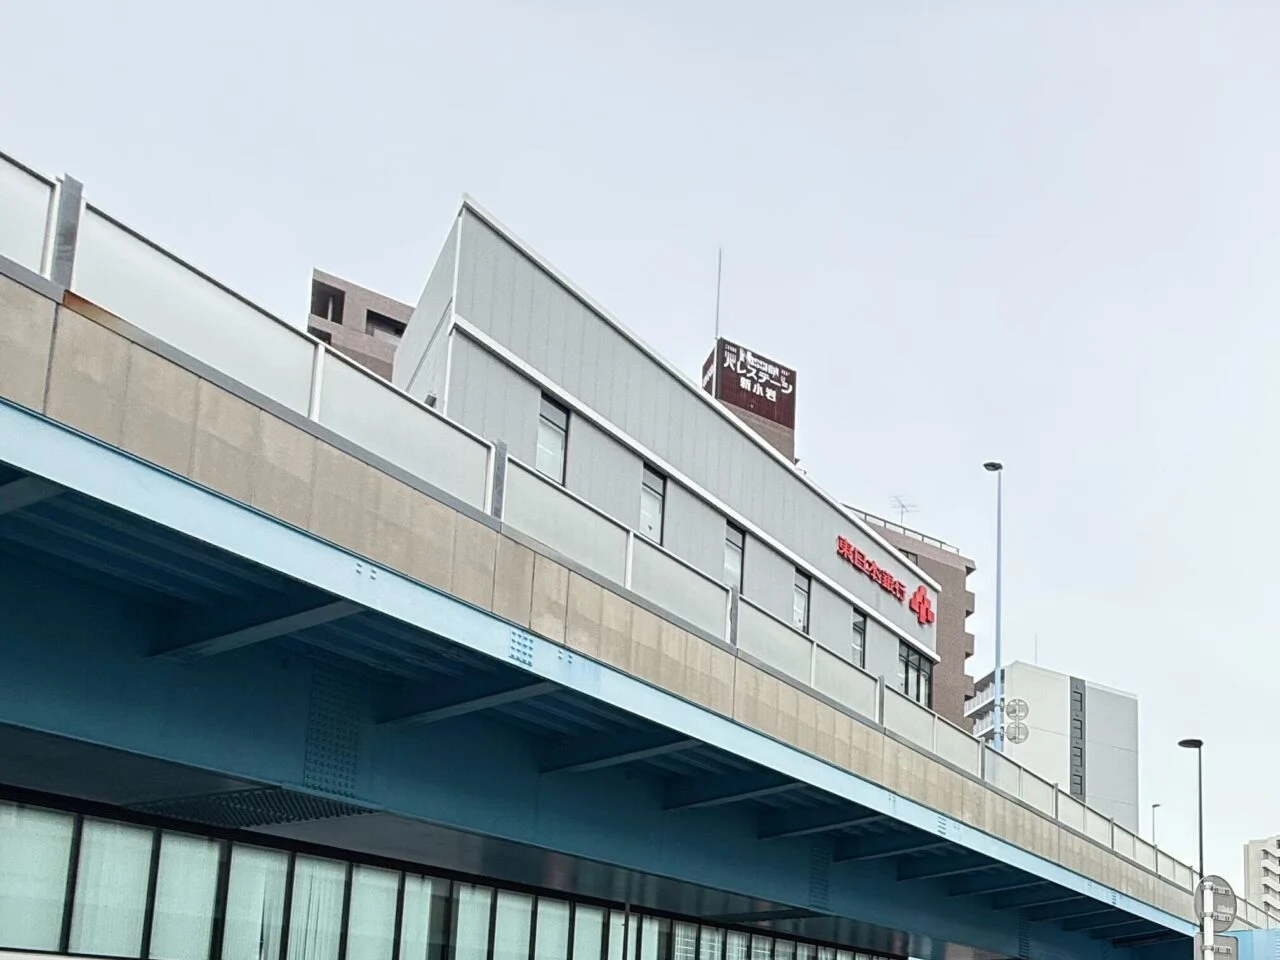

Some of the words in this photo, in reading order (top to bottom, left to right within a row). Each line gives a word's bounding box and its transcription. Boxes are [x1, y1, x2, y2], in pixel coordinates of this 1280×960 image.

[740, 376, 777, 402] 新小岩
[836, 535, 906, 603] 東日本銀行
